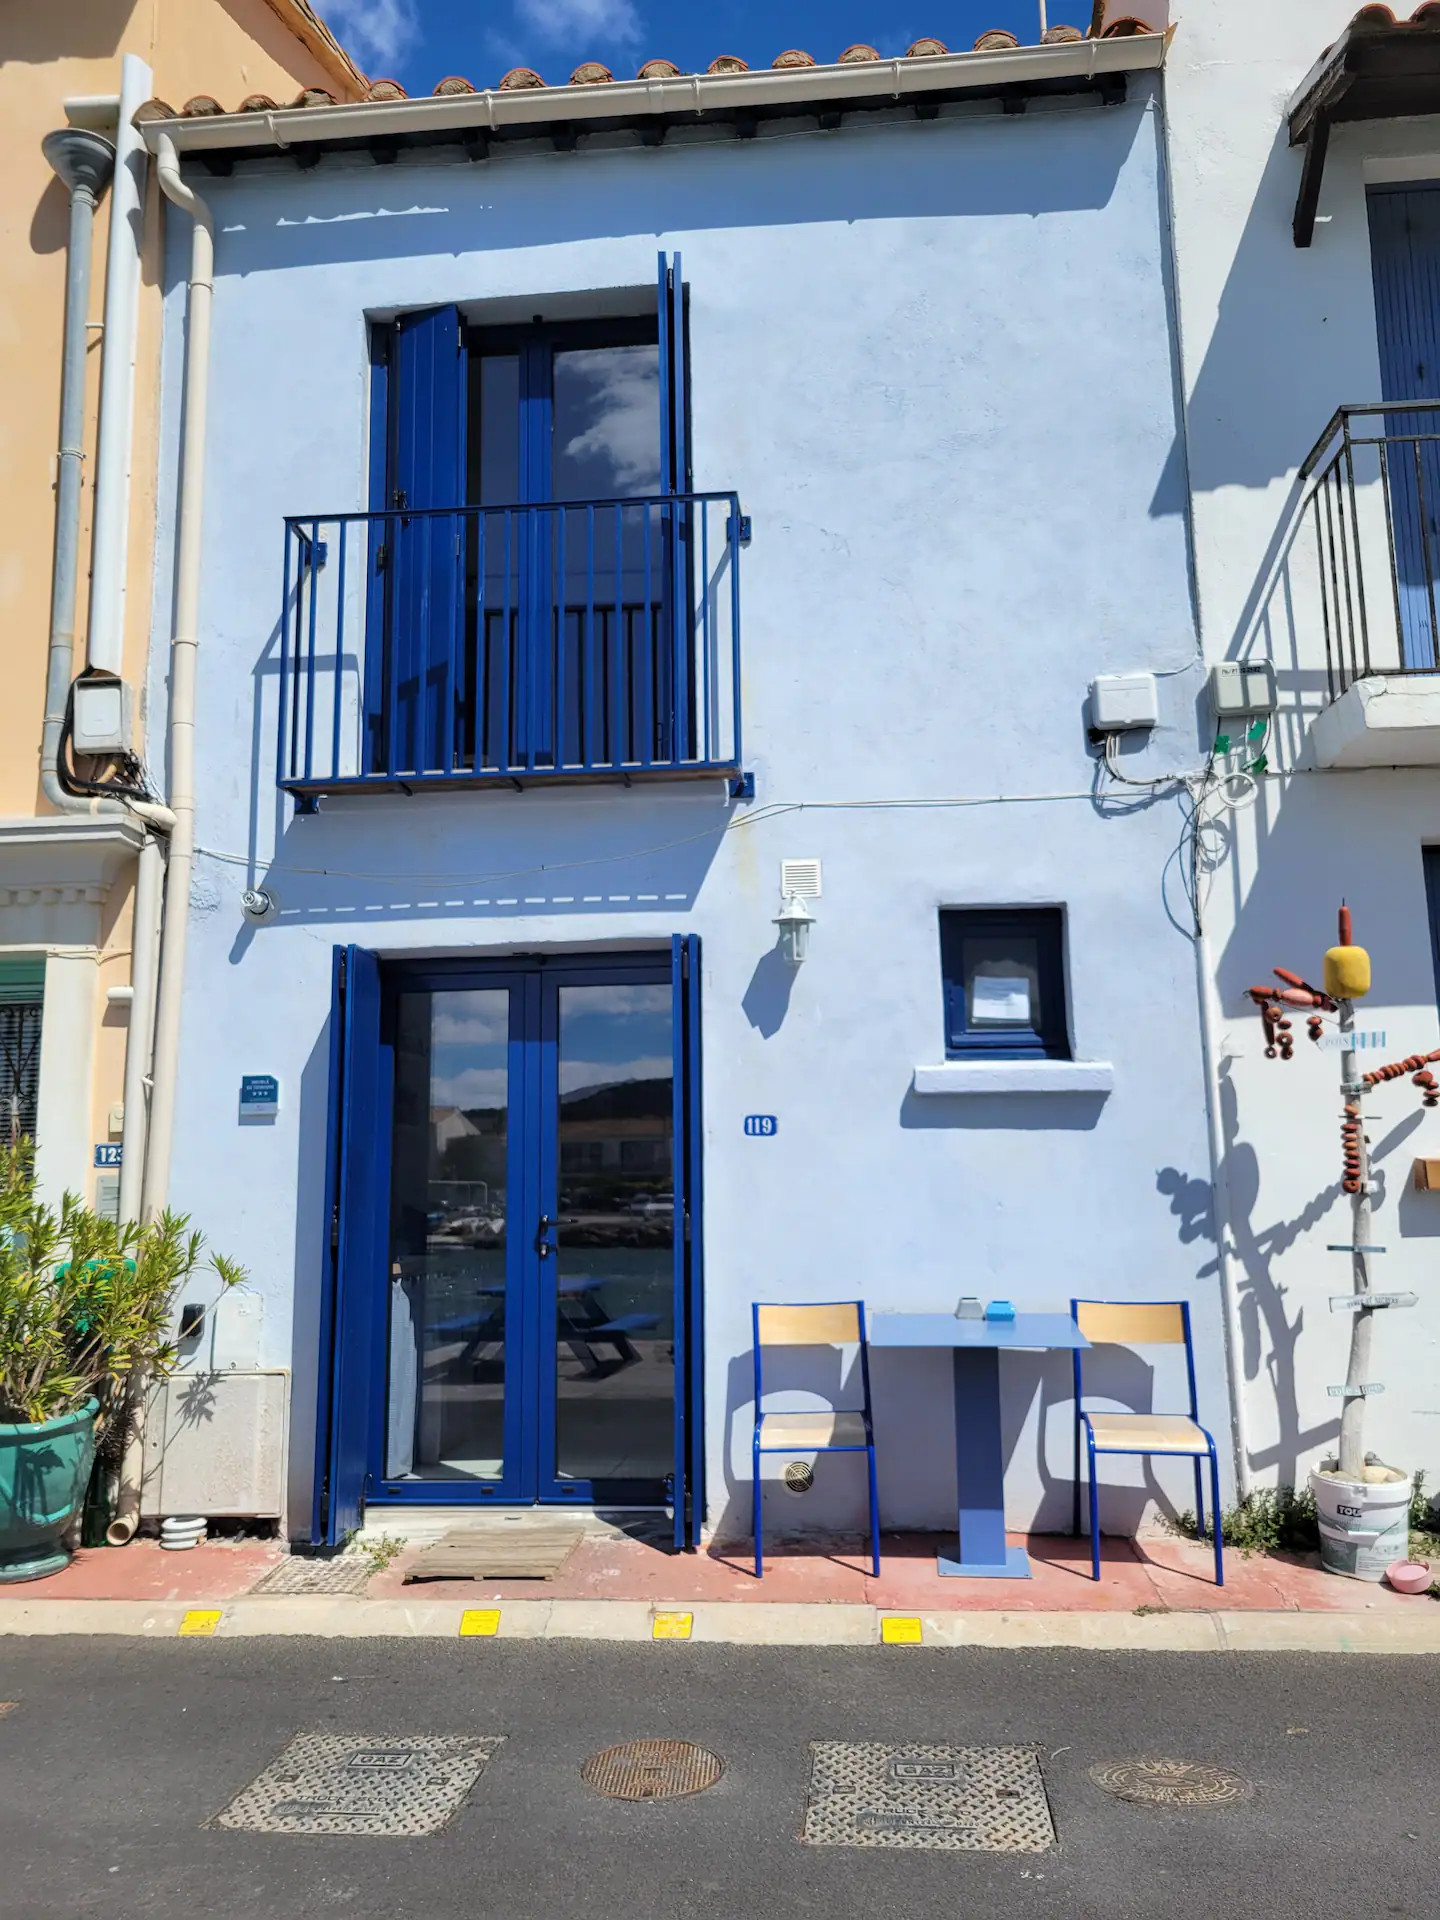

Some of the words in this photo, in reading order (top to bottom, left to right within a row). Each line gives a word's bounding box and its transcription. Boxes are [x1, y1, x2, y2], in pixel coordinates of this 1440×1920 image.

[747, 1117, 772, 1134] 119
[360, 1756, 402, 1764] GAZ
[903, 1767, 946, 1777] GAZ
[872, 1807, 929, 1815] TRUCK
